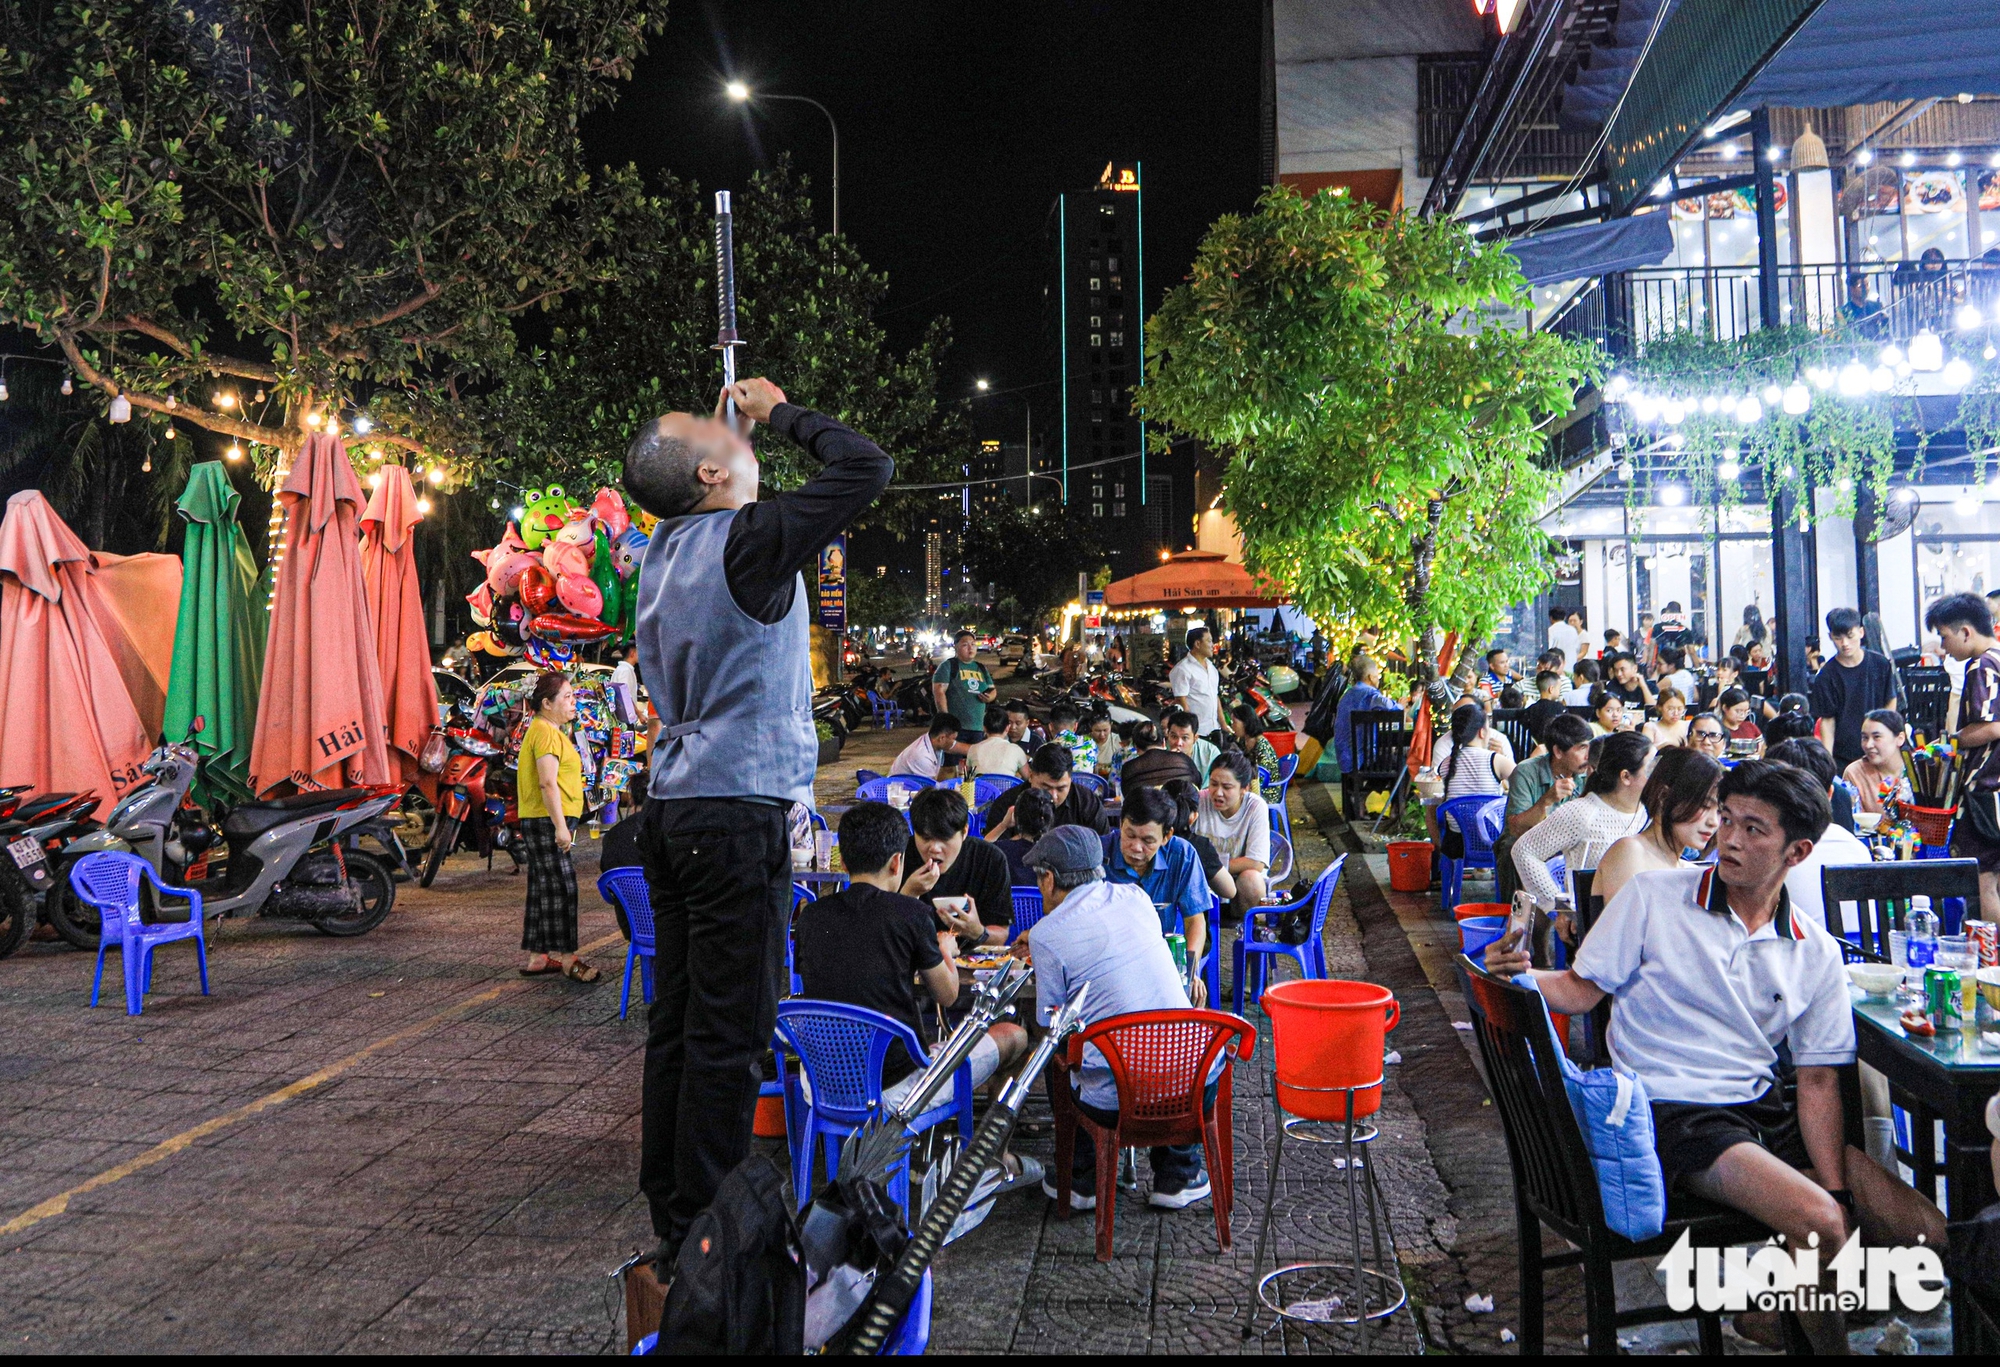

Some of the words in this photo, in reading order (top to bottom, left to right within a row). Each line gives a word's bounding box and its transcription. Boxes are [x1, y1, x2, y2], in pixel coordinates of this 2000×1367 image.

[1163, 588, 1181, 597] Hải
[1184, 587, 1203, 596] Sản
[1661, 614, 1686, 622] OPEN
[960, 670, 984, 682] LUCKY
[317, 721, 364, 757] Hải
[110, 761, 146, 790] Sả
